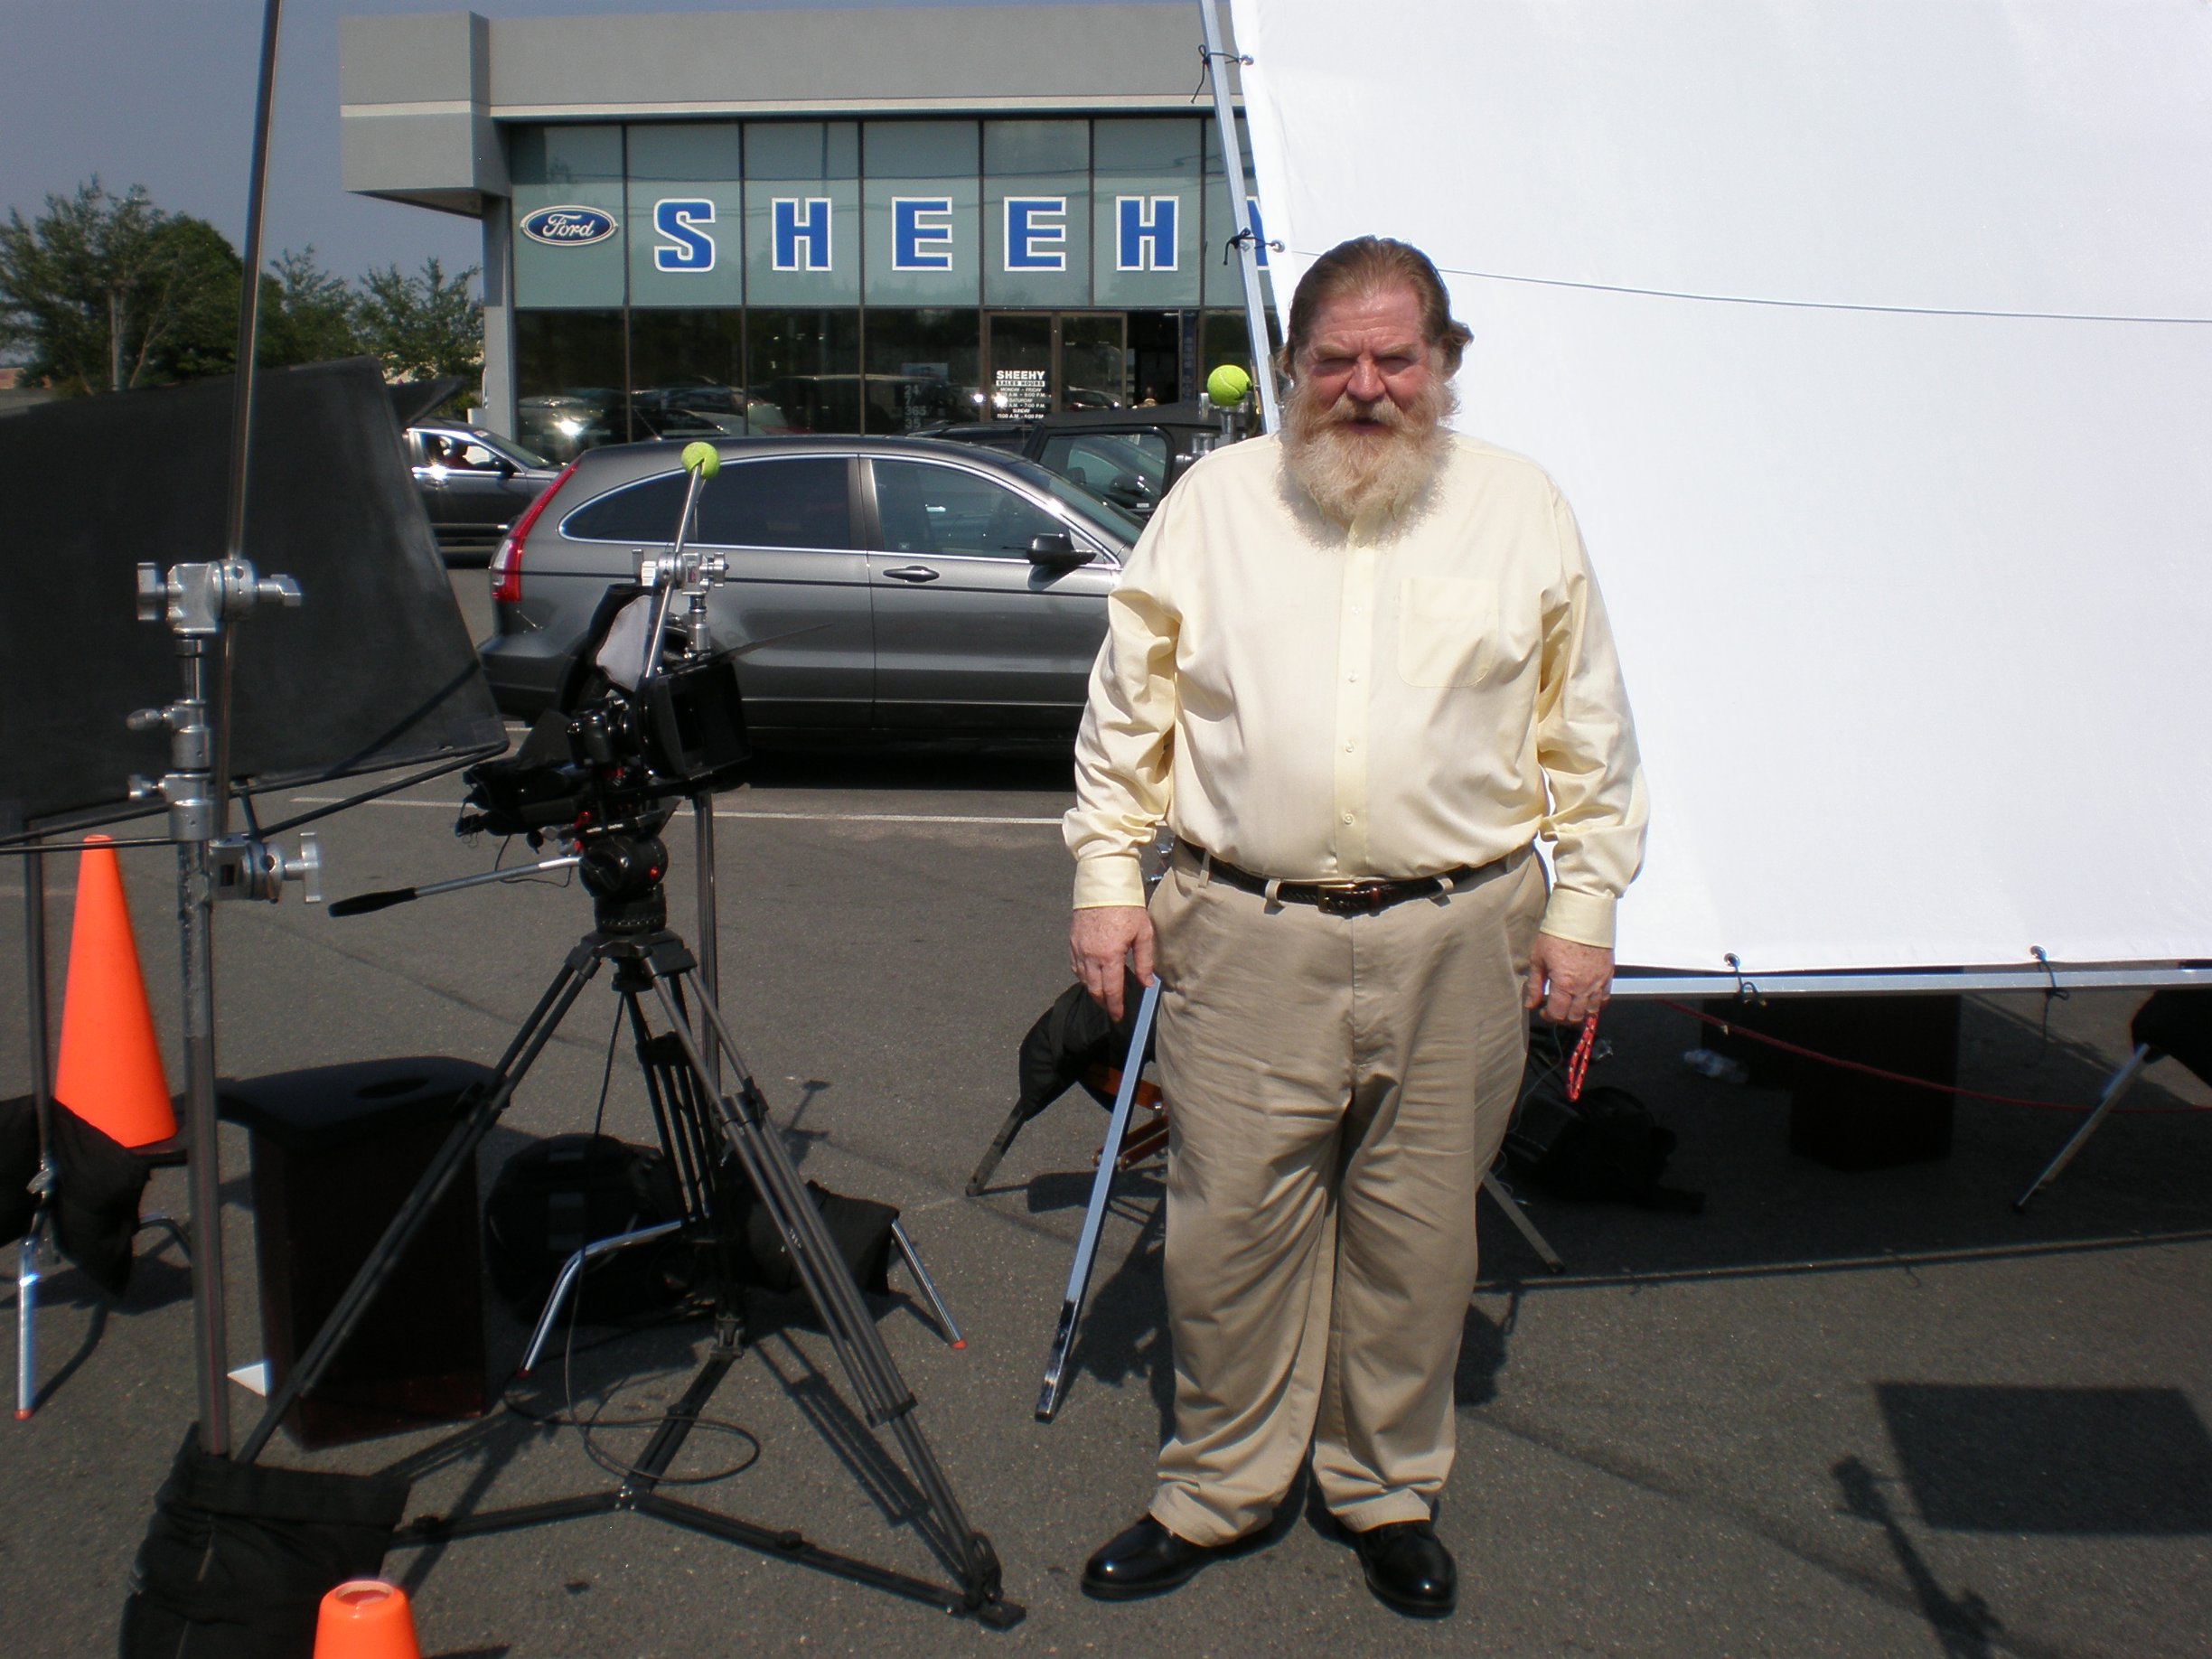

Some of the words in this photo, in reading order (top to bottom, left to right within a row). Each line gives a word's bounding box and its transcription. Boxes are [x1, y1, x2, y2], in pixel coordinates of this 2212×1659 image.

[542, 213, 595, 237] Ford
[653, 195, 1270, 272] SHEEH
[996, 370, 1045, 380] SHEEHY
